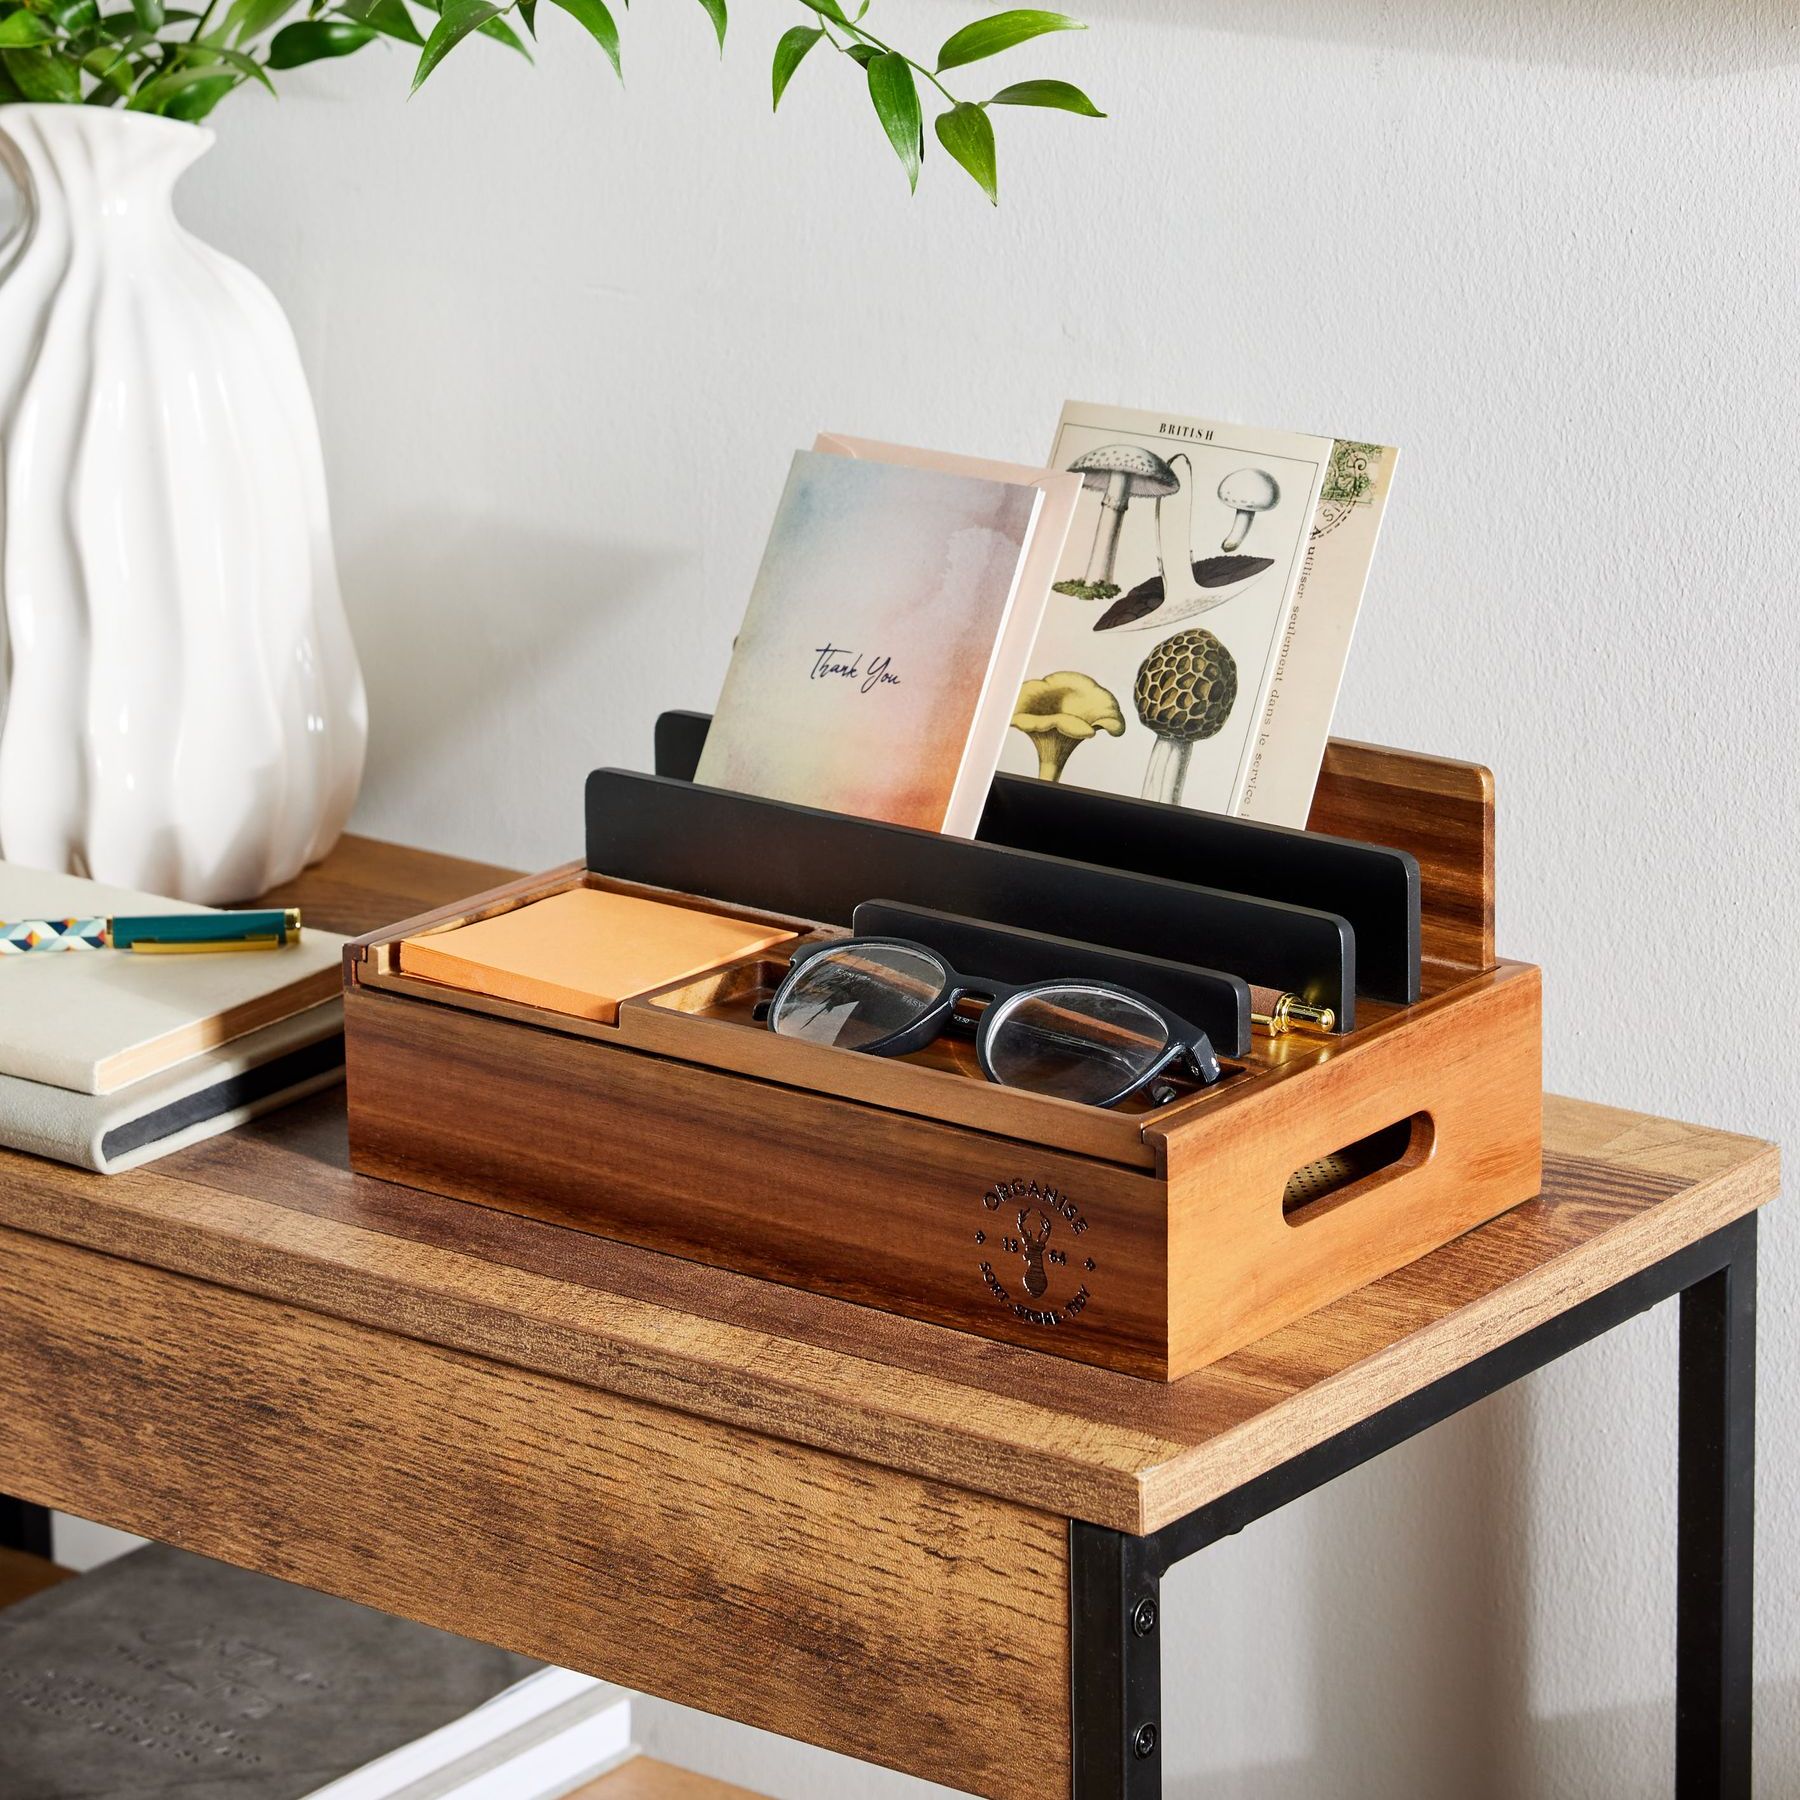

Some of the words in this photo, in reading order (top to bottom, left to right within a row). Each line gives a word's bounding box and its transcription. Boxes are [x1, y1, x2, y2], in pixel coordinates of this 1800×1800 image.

[1159, 422, 1214, 441] BRITISH
[1297, 546, 1316, 598] utiliser
[810, 643, 863, 679] Thank
[860, 656, 901, 693] You
[1274, 606, 1299, 681] seulement
[1264, 690, 1279, 725] dans
[1259, 733, 1270, 746] le
[1243, 752, 1262, 805] service
[982, 1177, 1089, 1236] ORGANISE
